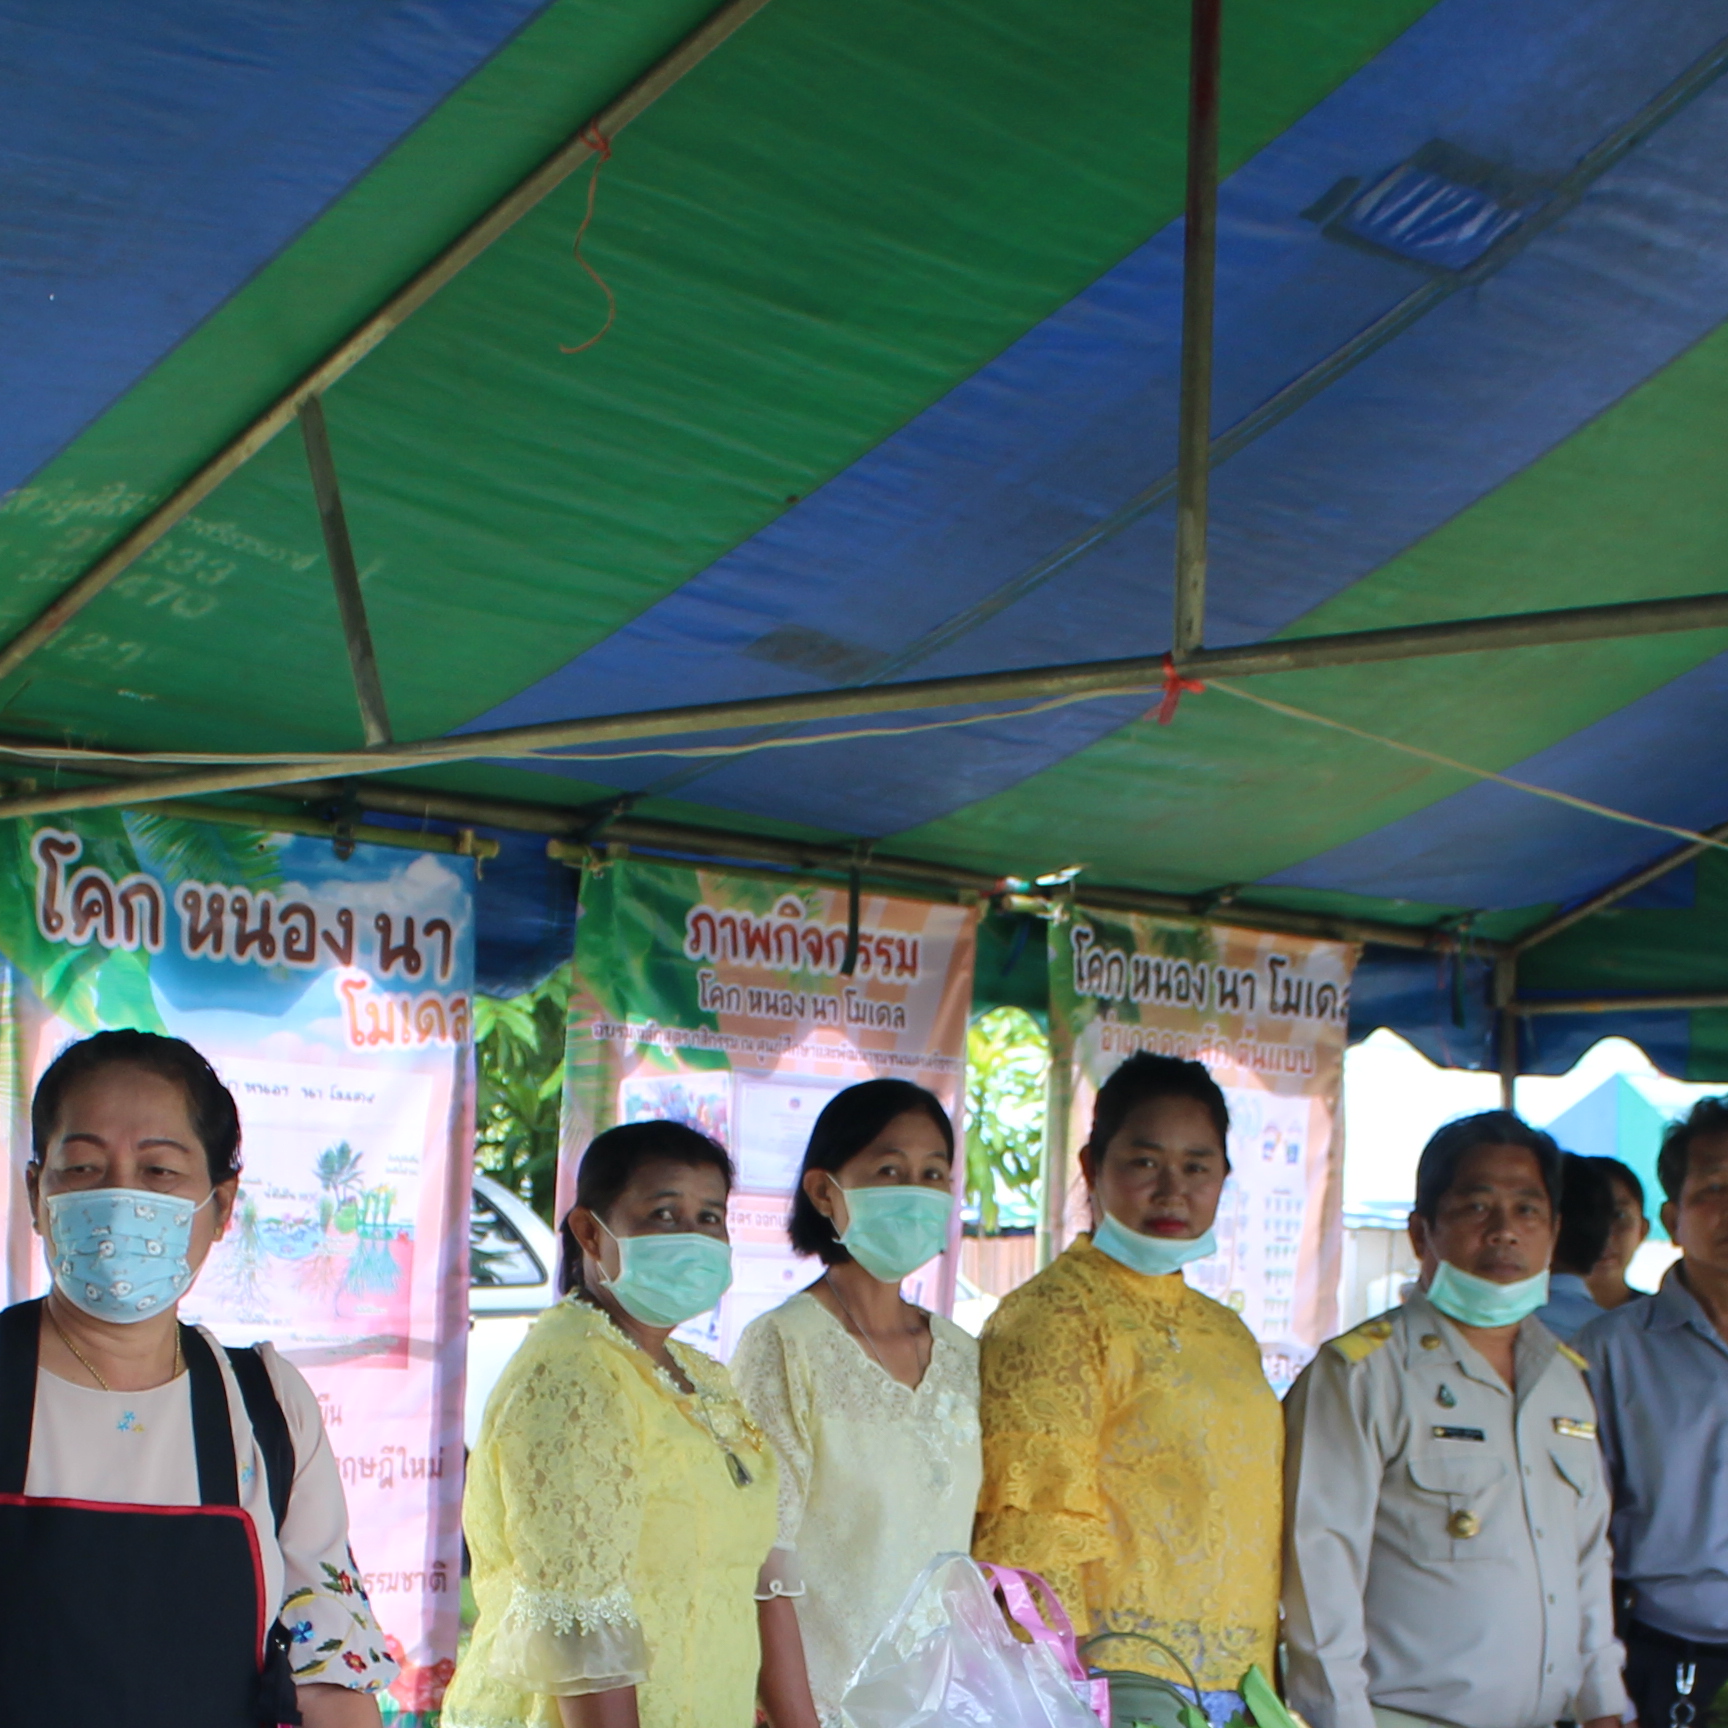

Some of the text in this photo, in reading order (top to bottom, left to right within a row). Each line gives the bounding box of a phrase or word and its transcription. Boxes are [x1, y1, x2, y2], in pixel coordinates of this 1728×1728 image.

[36, 834, 454, 981] โคก หนอง นา
[687, 900, 920, 980] ภาพกิจกรรม
[698, 971, 907, 1029] โคก หนอง นา โมเดล
[1073, 928, 1125, 996] โคก
[1131, 954, 1207, 1008] หนอง
[1216, 966, 1257, 1012] นา
[339, 977, 469, 1048] โมเดล
[1236, 1026, 1314, 1075] ต้นแบบ
[362, 1560, 448, 1595] รรมชาติ
